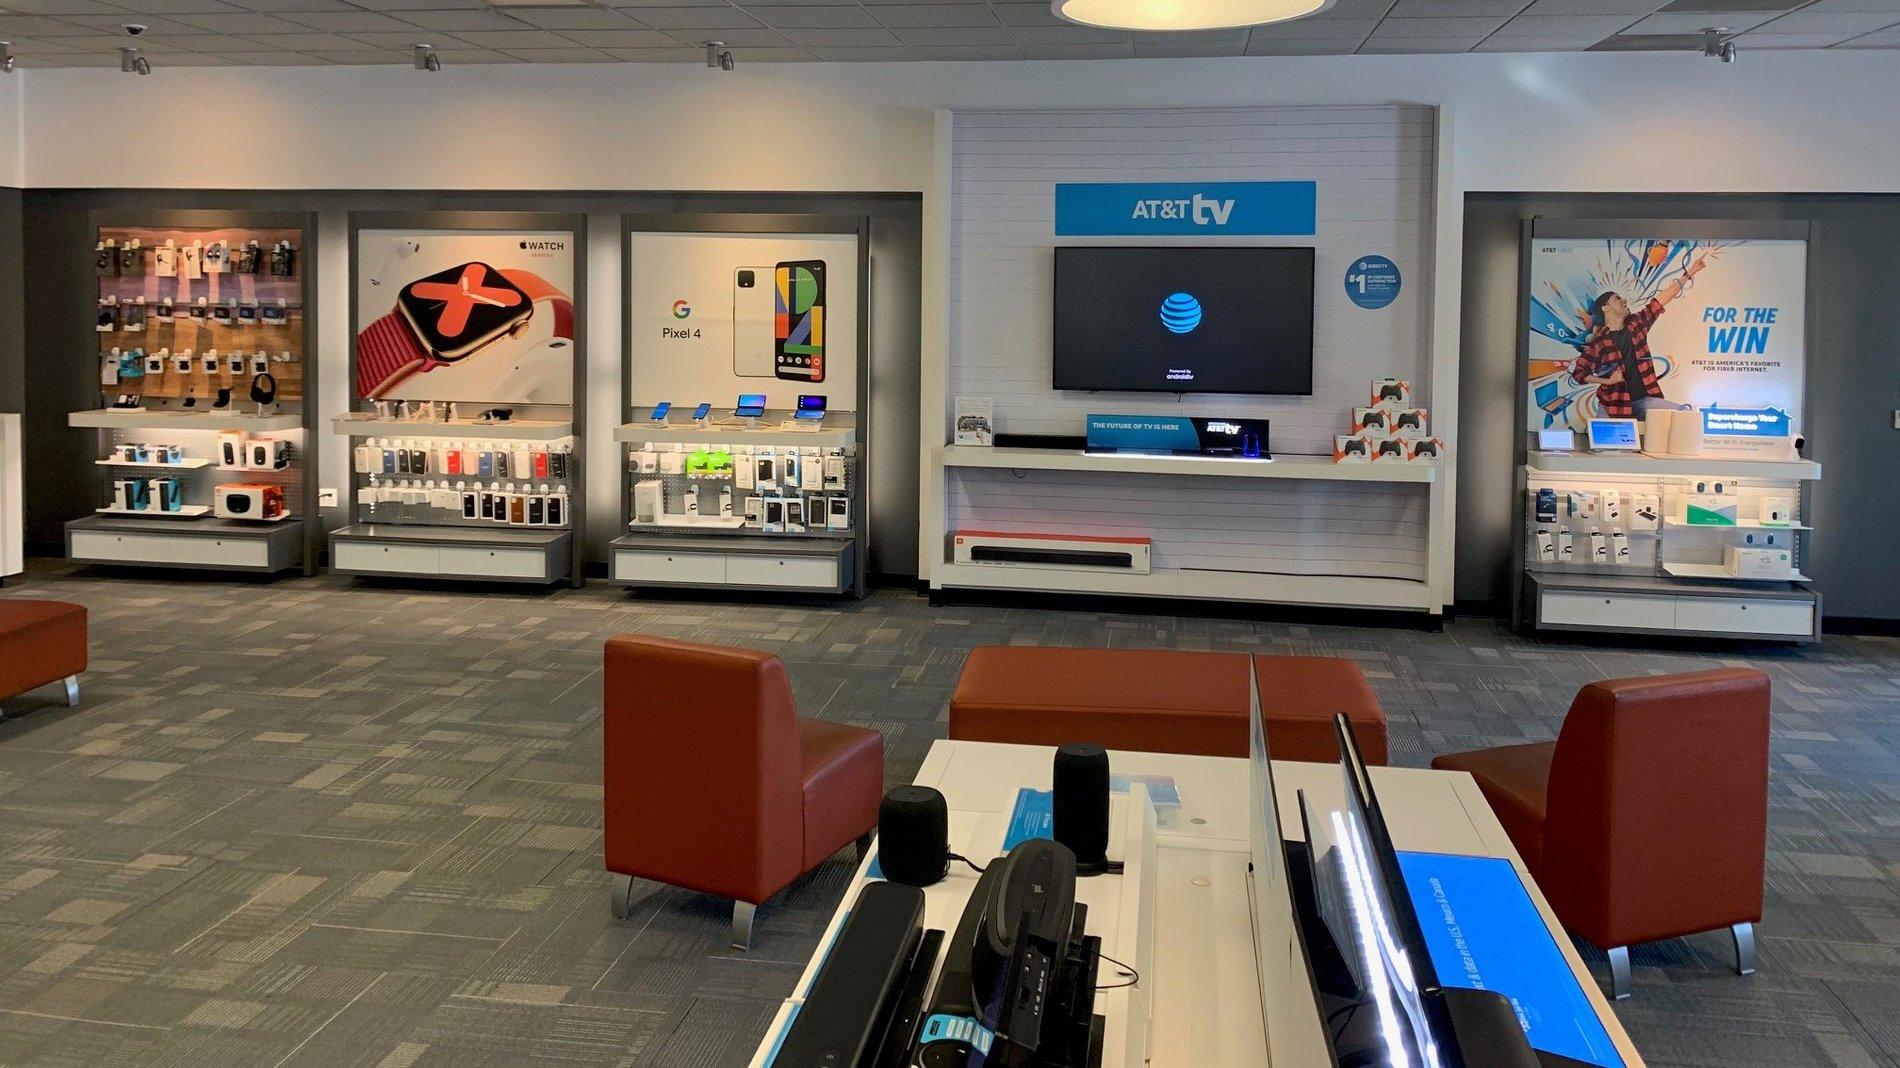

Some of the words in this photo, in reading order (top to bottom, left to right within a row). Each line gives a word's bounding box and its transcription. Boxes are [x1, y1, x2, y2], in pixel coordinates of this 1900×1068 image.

[1132, 200, 1190, 219] AT&T
[1192, 193, 1236, 225] tv
[528, 241, 564, 251] WATCH
[1702, 306, 1738, 323] FOR
[1743, 307, 1779, 324] THE
[662, 327, 690, 339] Pixel
[693, 328, 701, 339] 4
[1707, 326, 1771, 354] WIN
[1106, 422, 1132, 430] FUTURE
